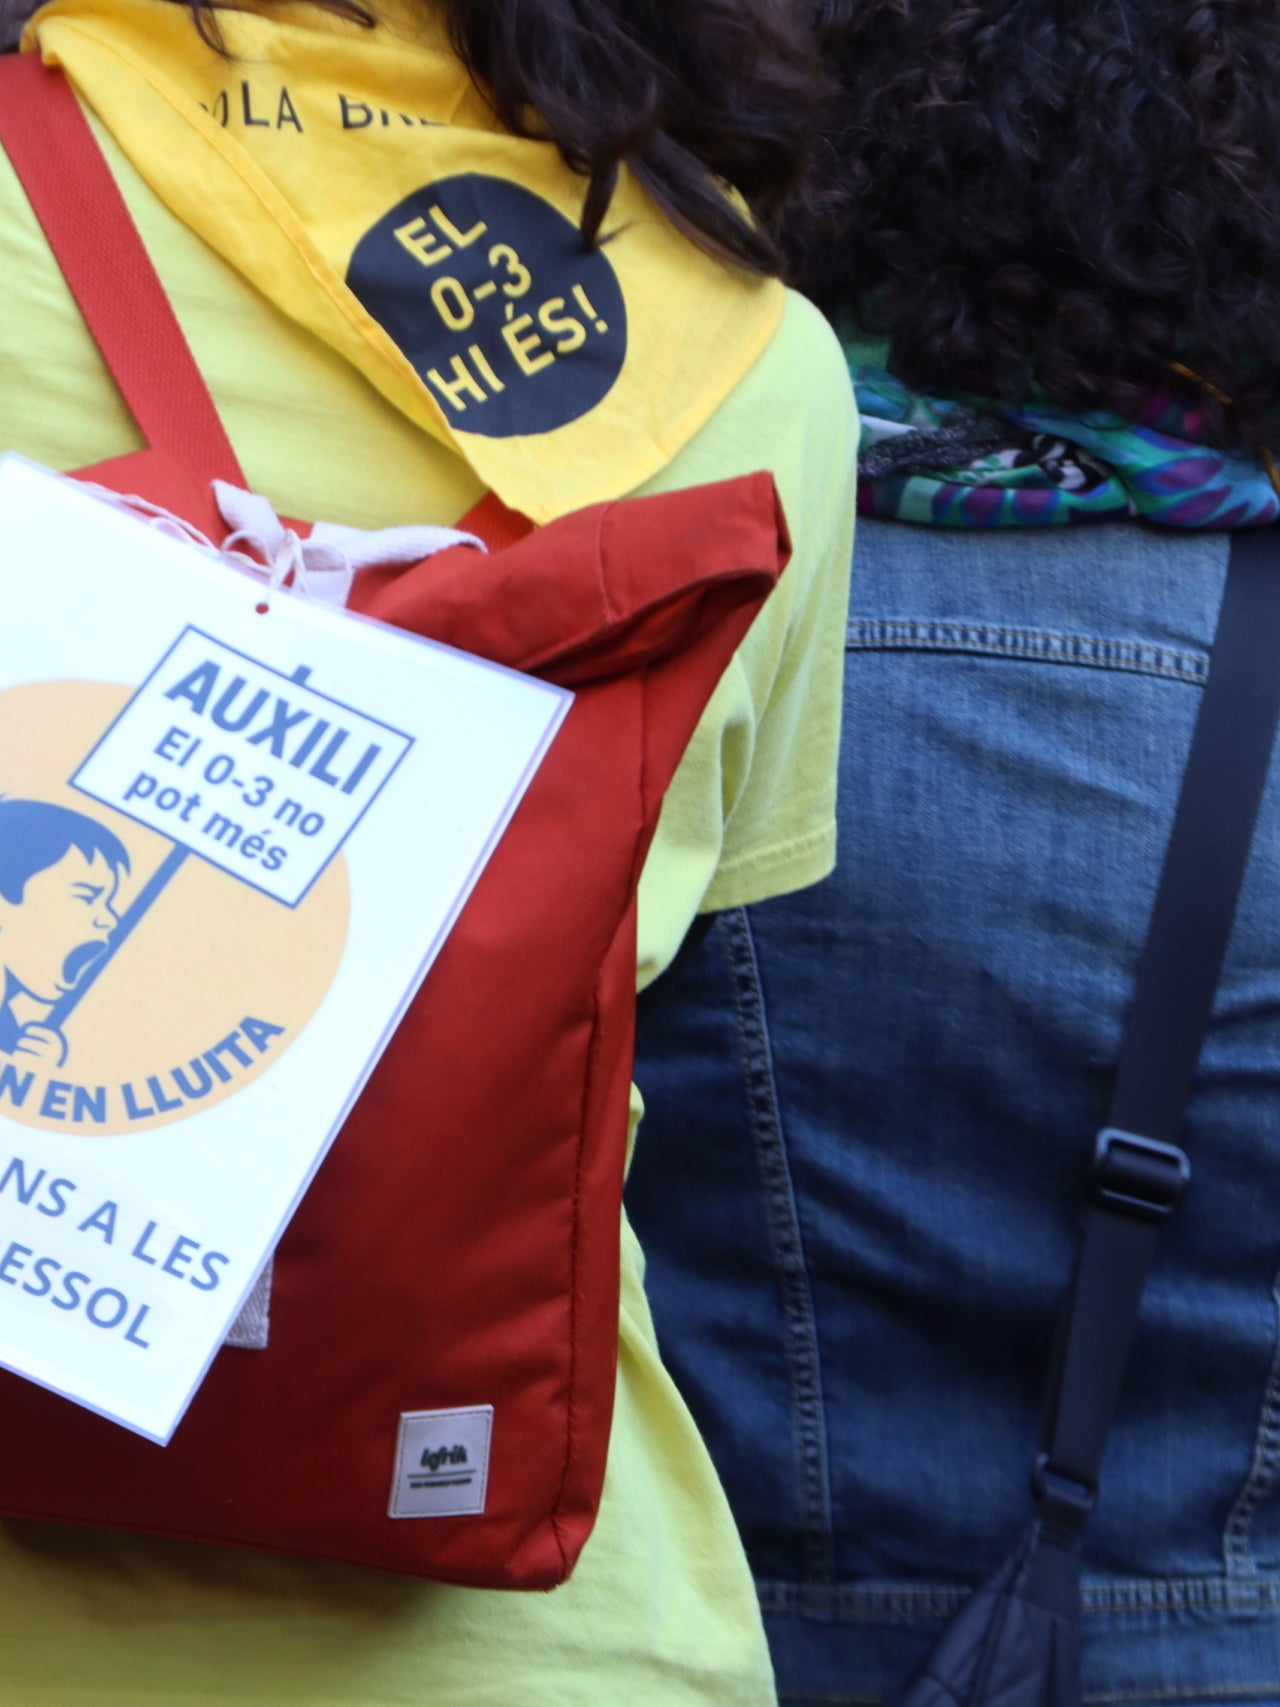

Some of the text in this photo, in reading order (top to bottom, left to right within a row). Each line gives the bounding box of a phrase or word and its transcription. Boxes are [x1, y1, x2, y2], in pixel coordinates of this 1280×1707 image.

[393, 204, 487, 267] EL
[430, 243, 531, 331] 0-3
[427, 283, 609, 411] HI ÉS!
[163, 660, 382, 795] AUXILI
[122, 772, 288, 871] pot més
[154, 726, 325, 837] El 0-3 no
[39, 1080, 106, 1124] EN
[121, 1016, 286, 1121] LLUITA
[78, 1201, 119, 1245] A
[131, 1221, 230, 1291] LES
